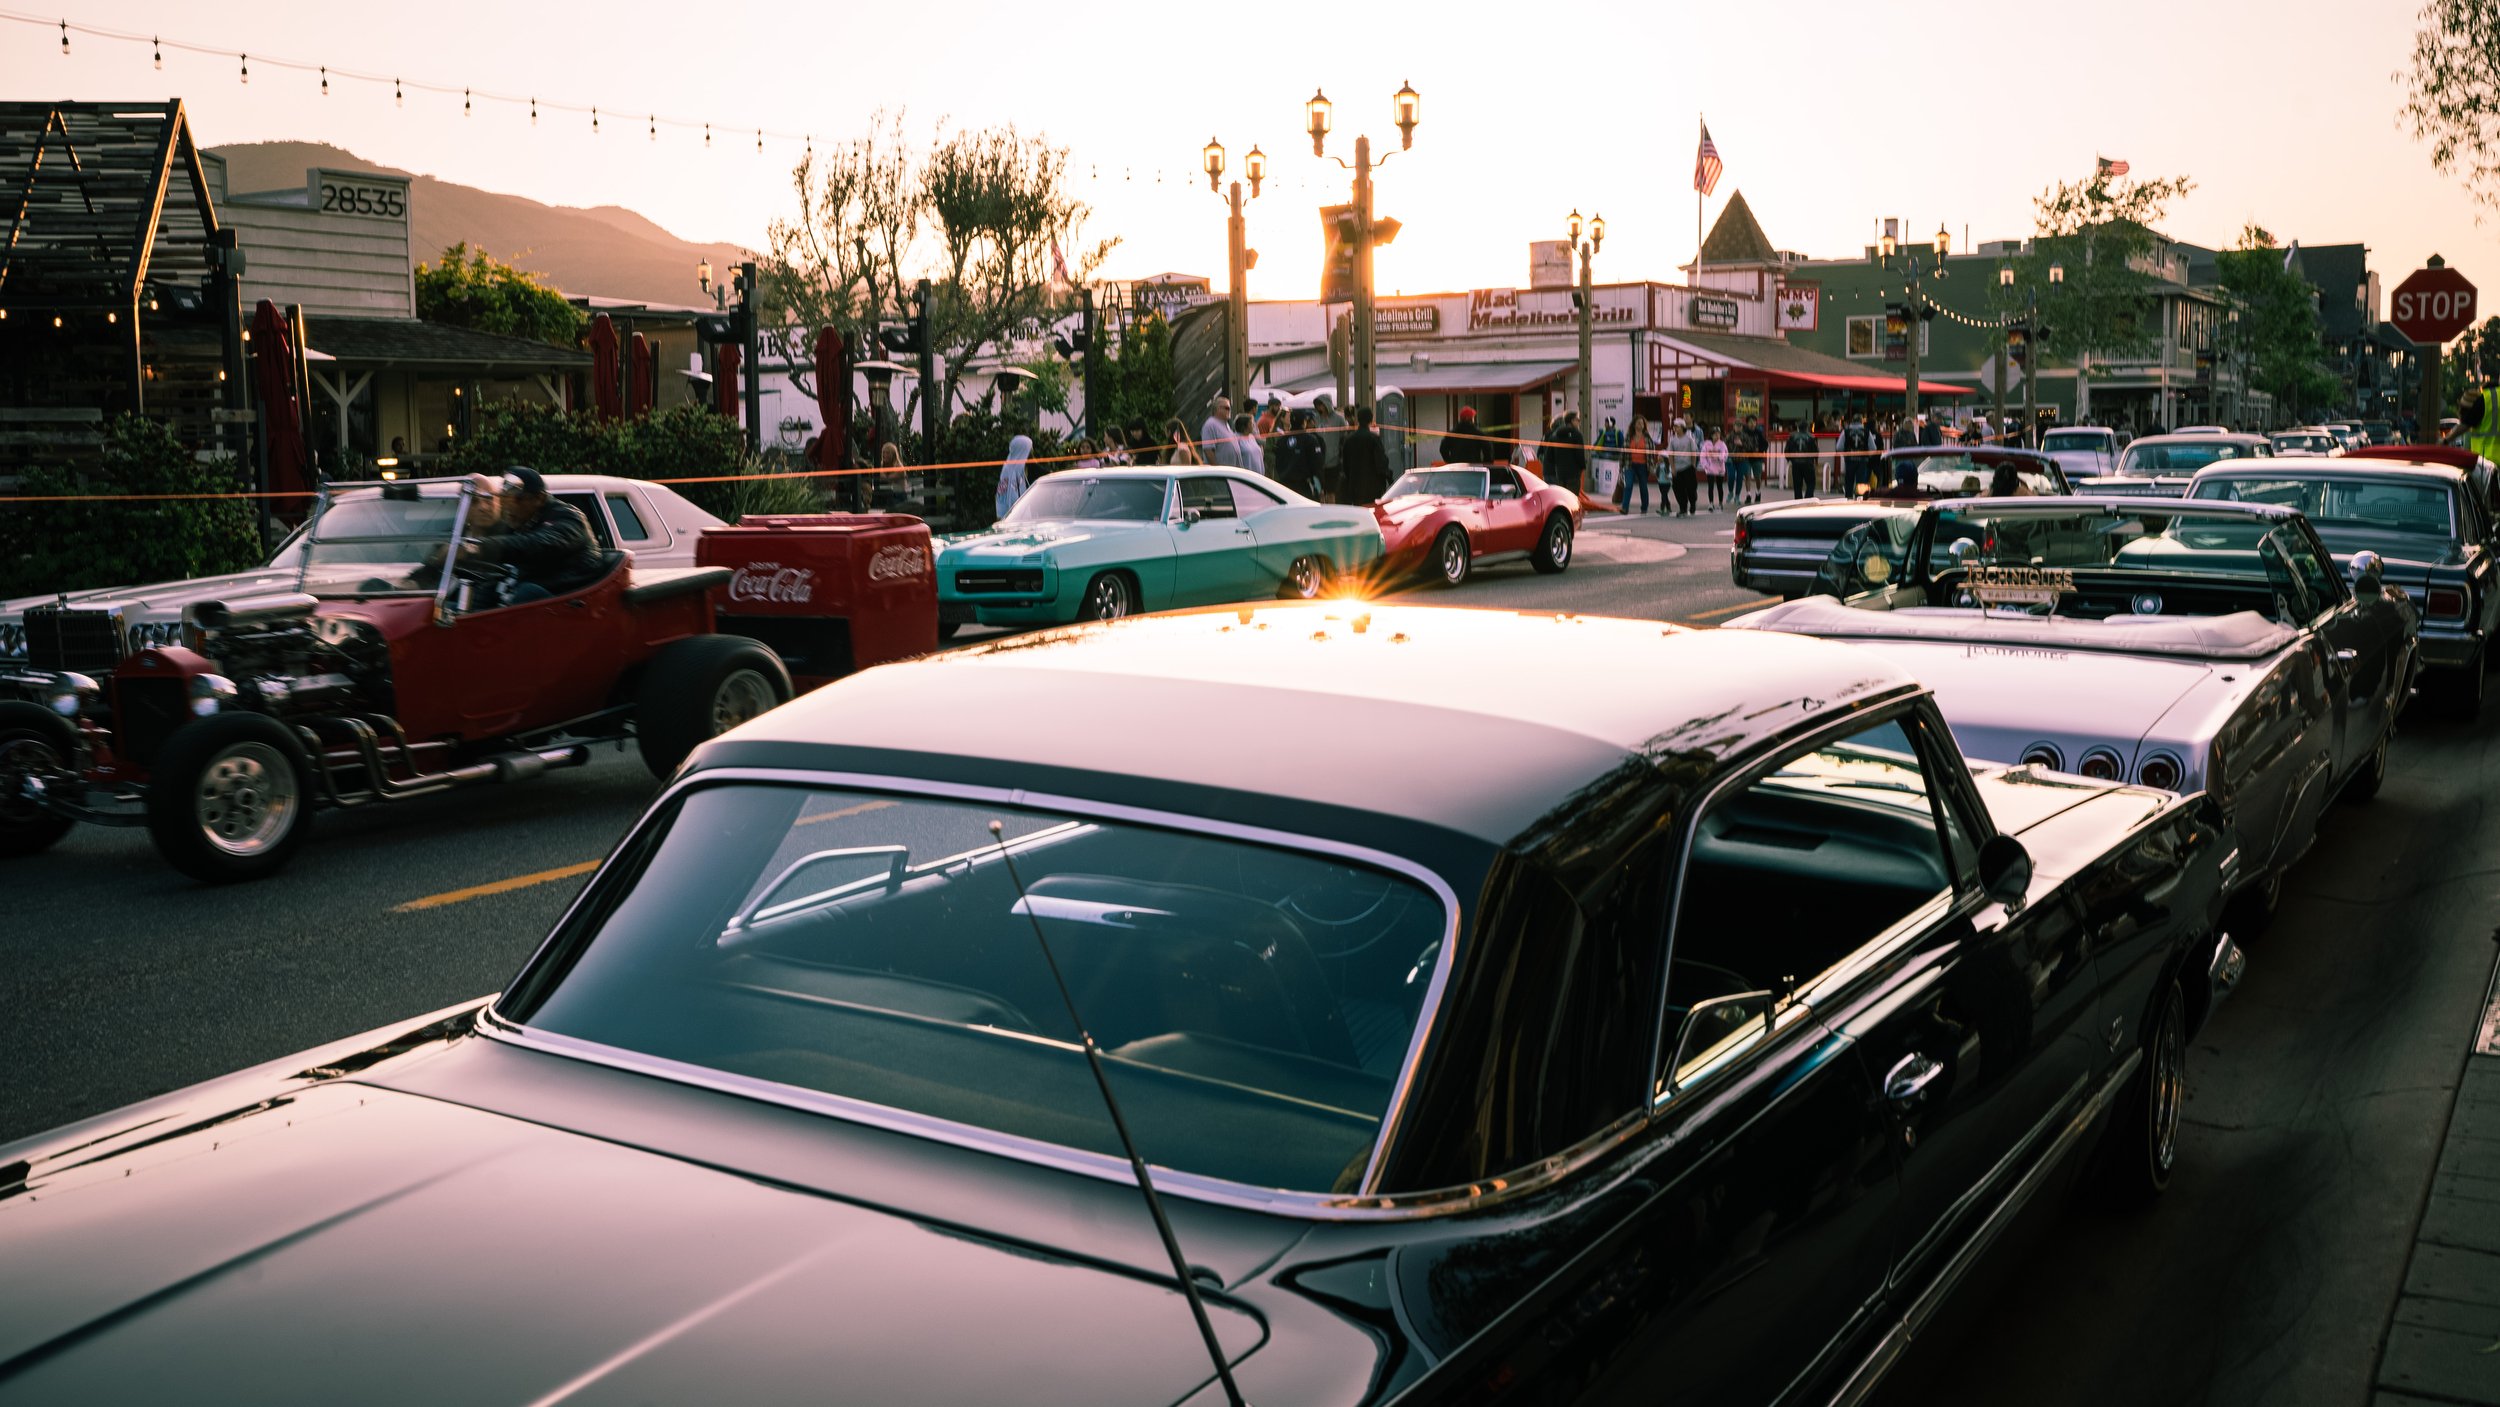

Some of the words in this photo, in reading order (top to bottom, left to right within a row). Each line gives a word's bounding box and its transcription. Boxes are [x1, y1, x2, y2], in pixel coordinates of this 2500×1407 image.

[321, 184, 403, 217] 28535
[1470, 288, 1517, 311] Mad
[2397, 290, 2471, 322] STOP
[1415, 307, 1433, 322] Grill
[1468, 308, 1580, 331] Madeline's
